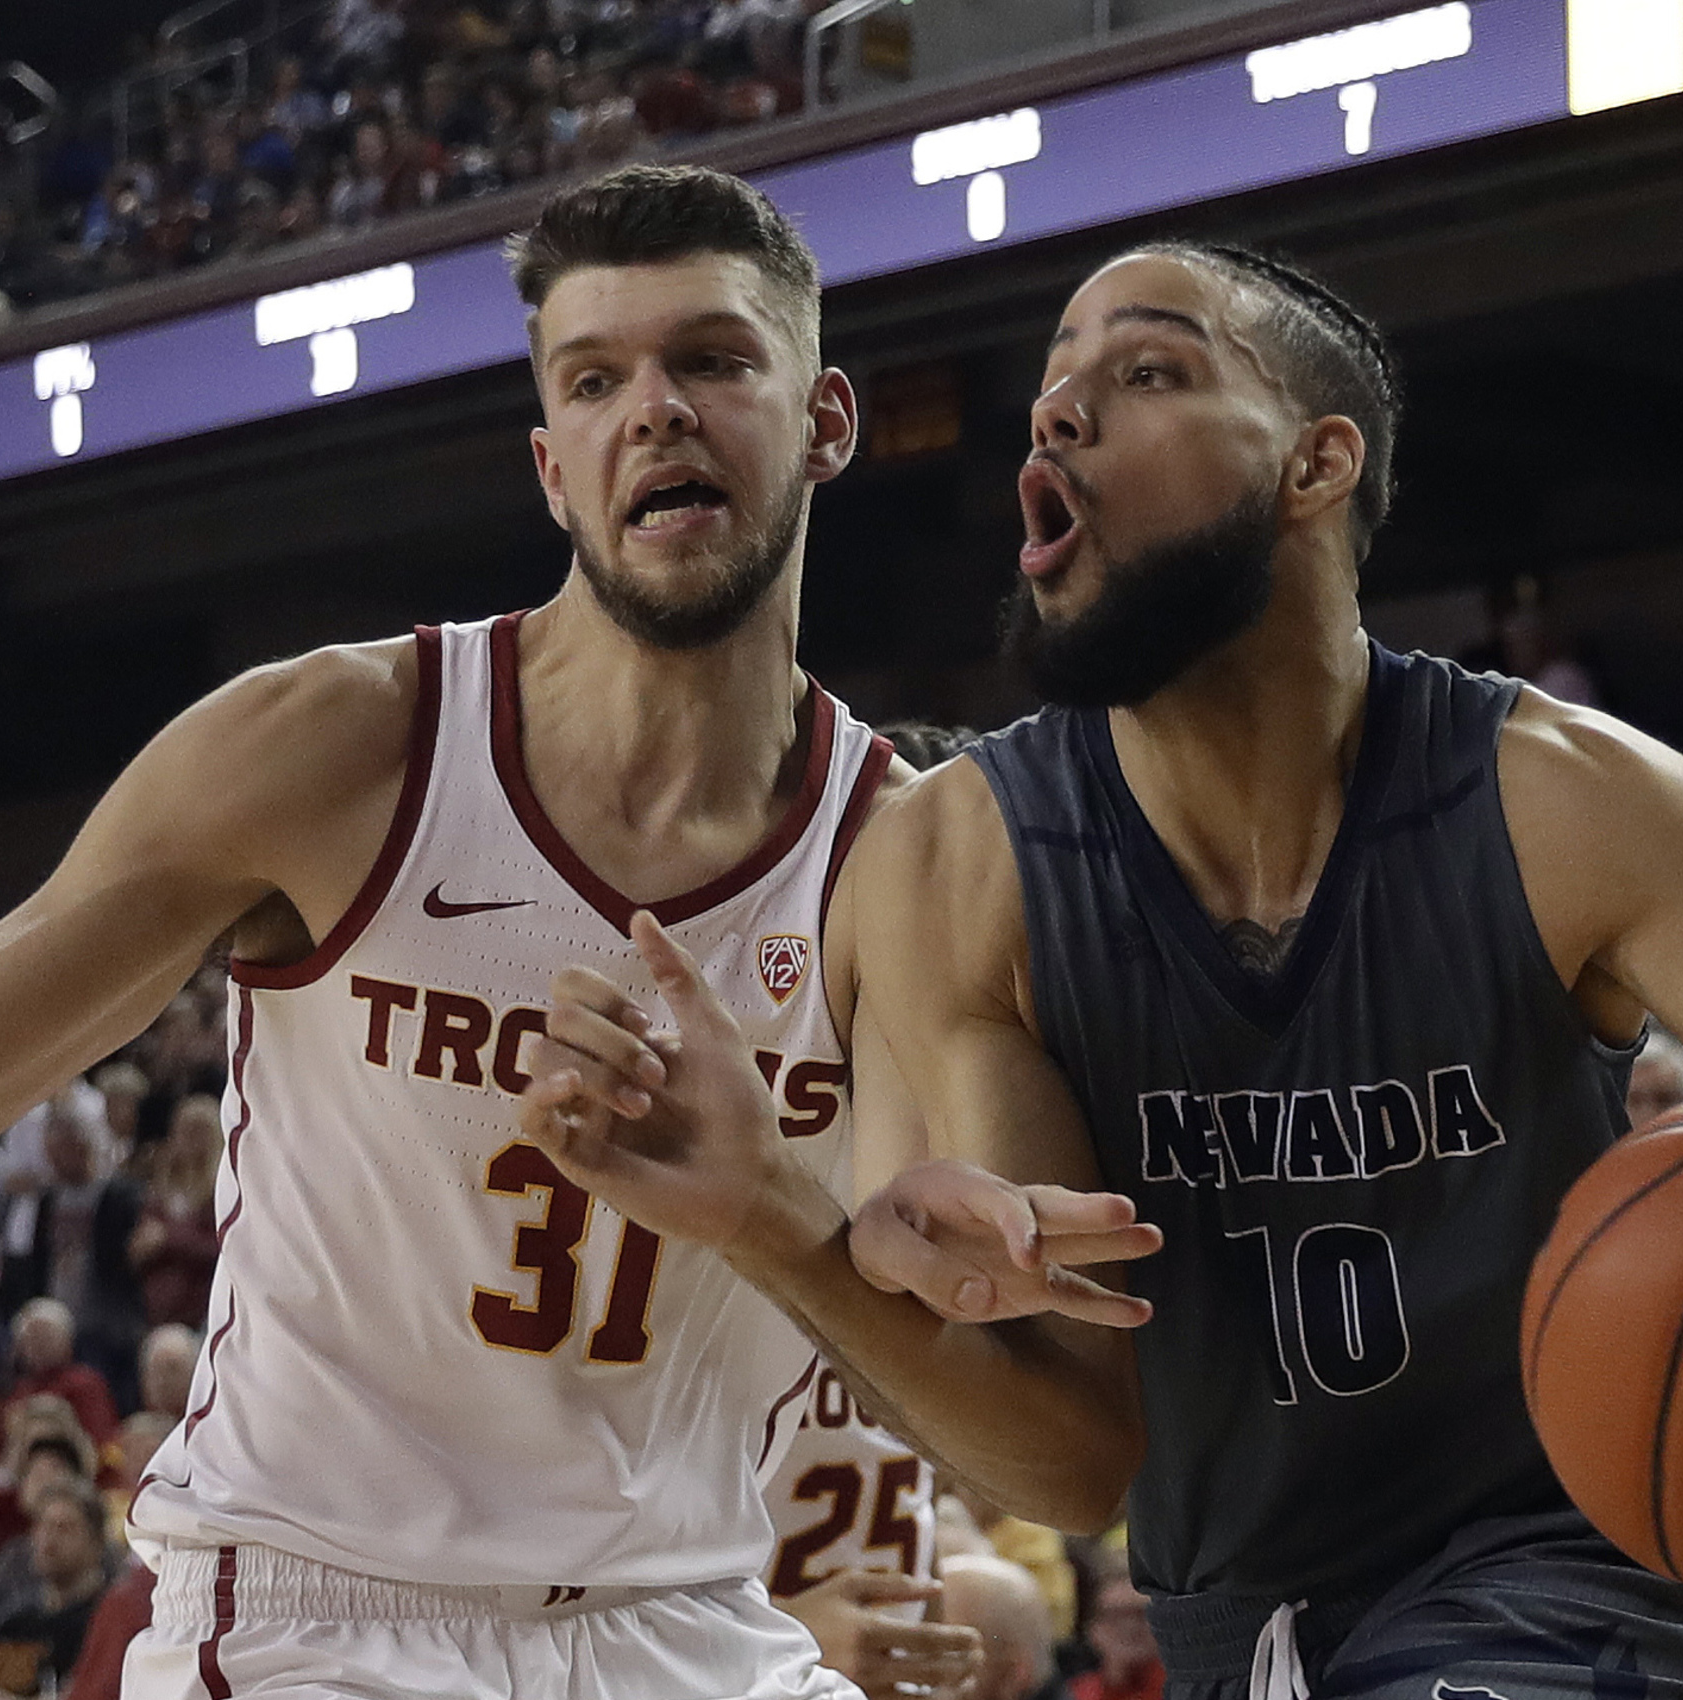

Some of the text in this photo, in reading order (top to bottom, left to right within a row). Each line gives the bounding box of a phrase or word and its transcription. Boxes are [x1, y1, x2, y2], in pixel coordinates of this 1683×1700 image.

[761, 937, 807, 976] PAC
[769, 963, 794, 989] 12
[350, 972, 851, 1139] TROS
[469, 1140, 664, 1365] 31
[1224, 1222, 1411, 1405] 10
[769, 1454, 919, 1599] 25
